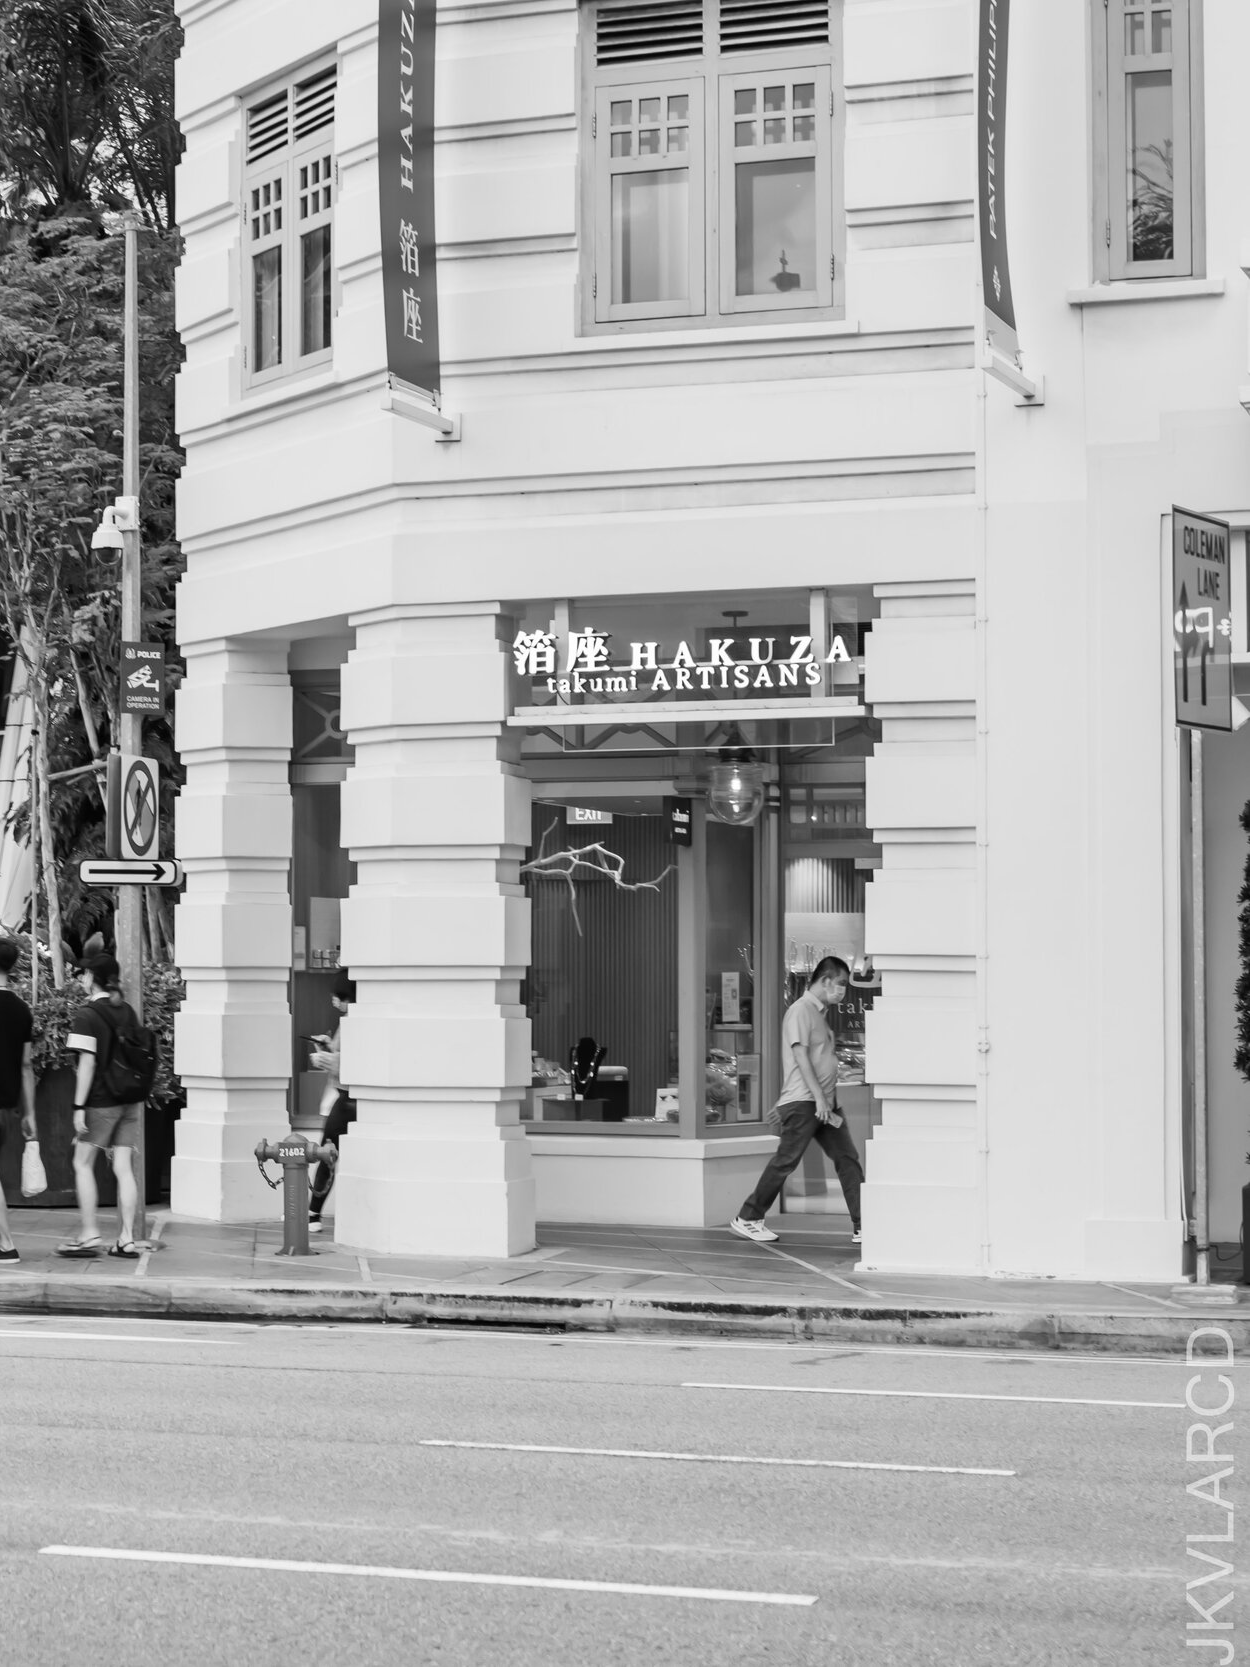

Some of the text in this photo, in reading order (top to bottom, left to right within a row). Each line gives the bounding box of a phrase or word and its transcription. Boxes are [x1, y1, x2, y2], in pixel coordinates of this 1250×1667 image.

[986, 0, 998, 241] PATEK PHILIP
[1183, 525, 1226, 565] COLEMAN
[1197, 567, 1220, 601] LANE
[137, 650, 161, 659] POLICE
[513, 626, 852, 676] 箔座 HAKUZA
[547, 662, 821, 694] takumi ARTISANS
[126, 695, 160, 704] CAMERA IN
[126, 702, 160, 710] OPERATION
[838, 997, 873, 1014] tak
[279, 1147, 305, 1157] 21602
